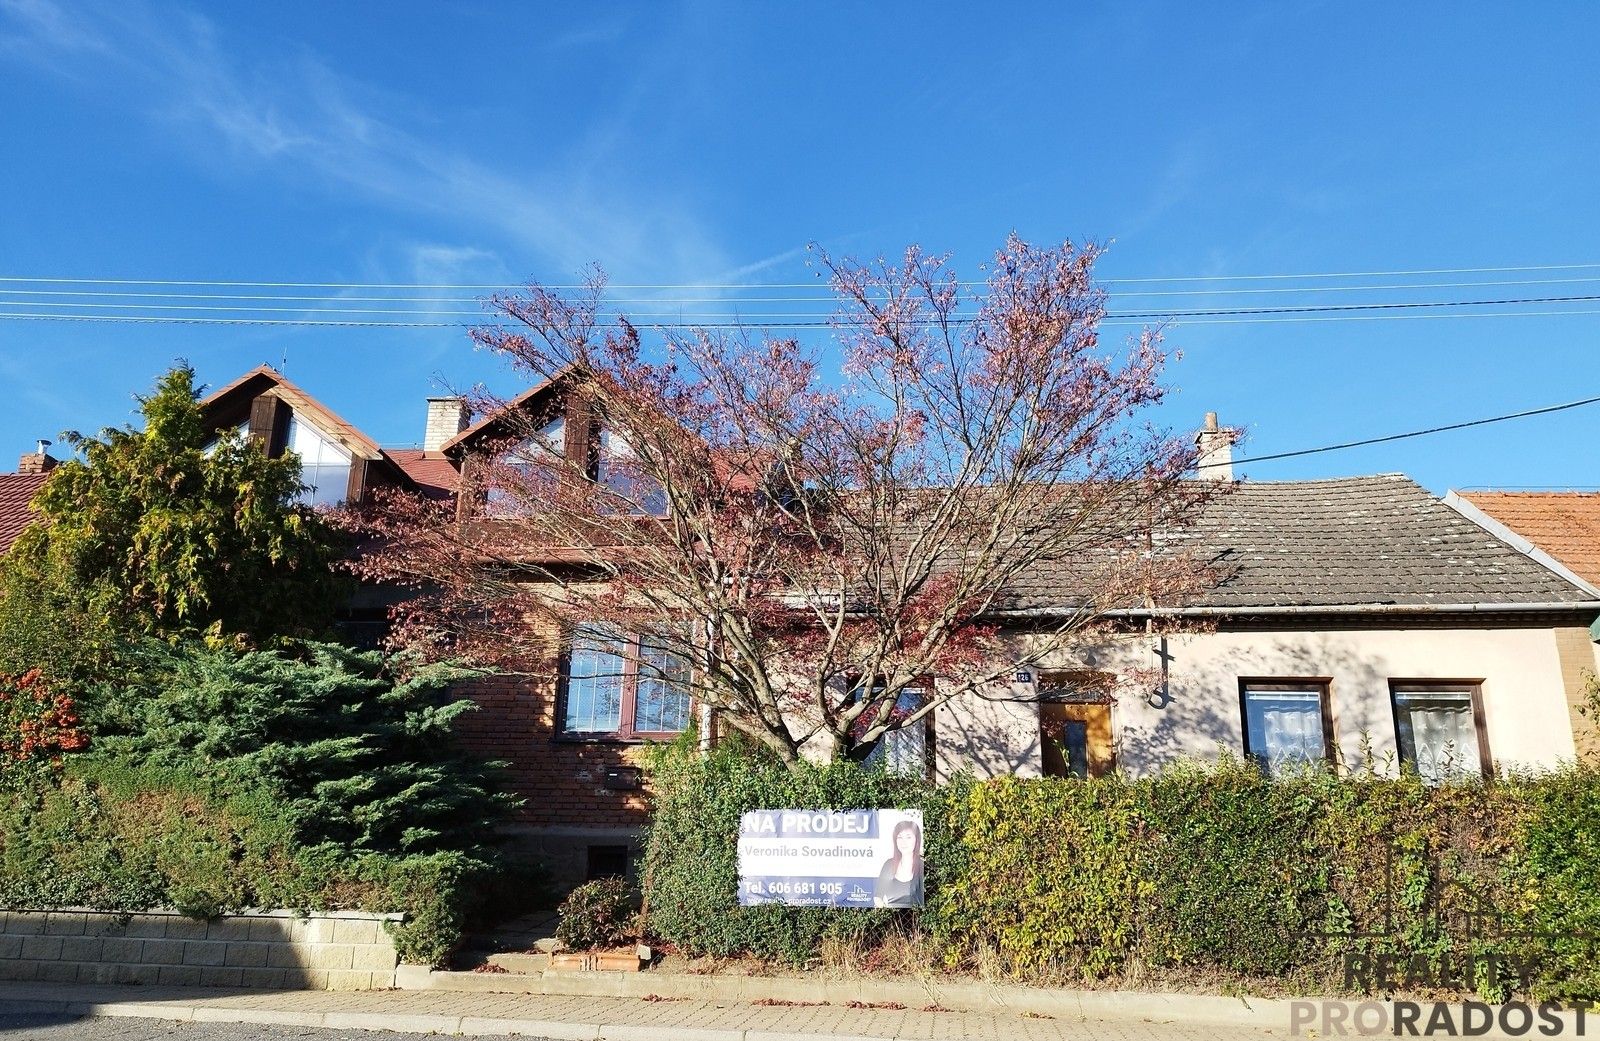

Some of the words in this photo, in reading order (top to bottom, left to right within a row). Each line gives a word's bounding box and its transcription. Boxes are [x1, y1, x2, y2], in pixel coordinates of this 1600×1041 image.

[744, 814, 776, 833] NA
[782, 814, 869, 834] PRODEJ
[745, 845, 798, 857] Veronika
[801, 844, 874, 858] Sovadinová
[745, 882, 765, 894] Tel.
[768, 882, 790, 894] 606
[794, 882, 815, 894] 681
[820, 883, 843, 895] 905
